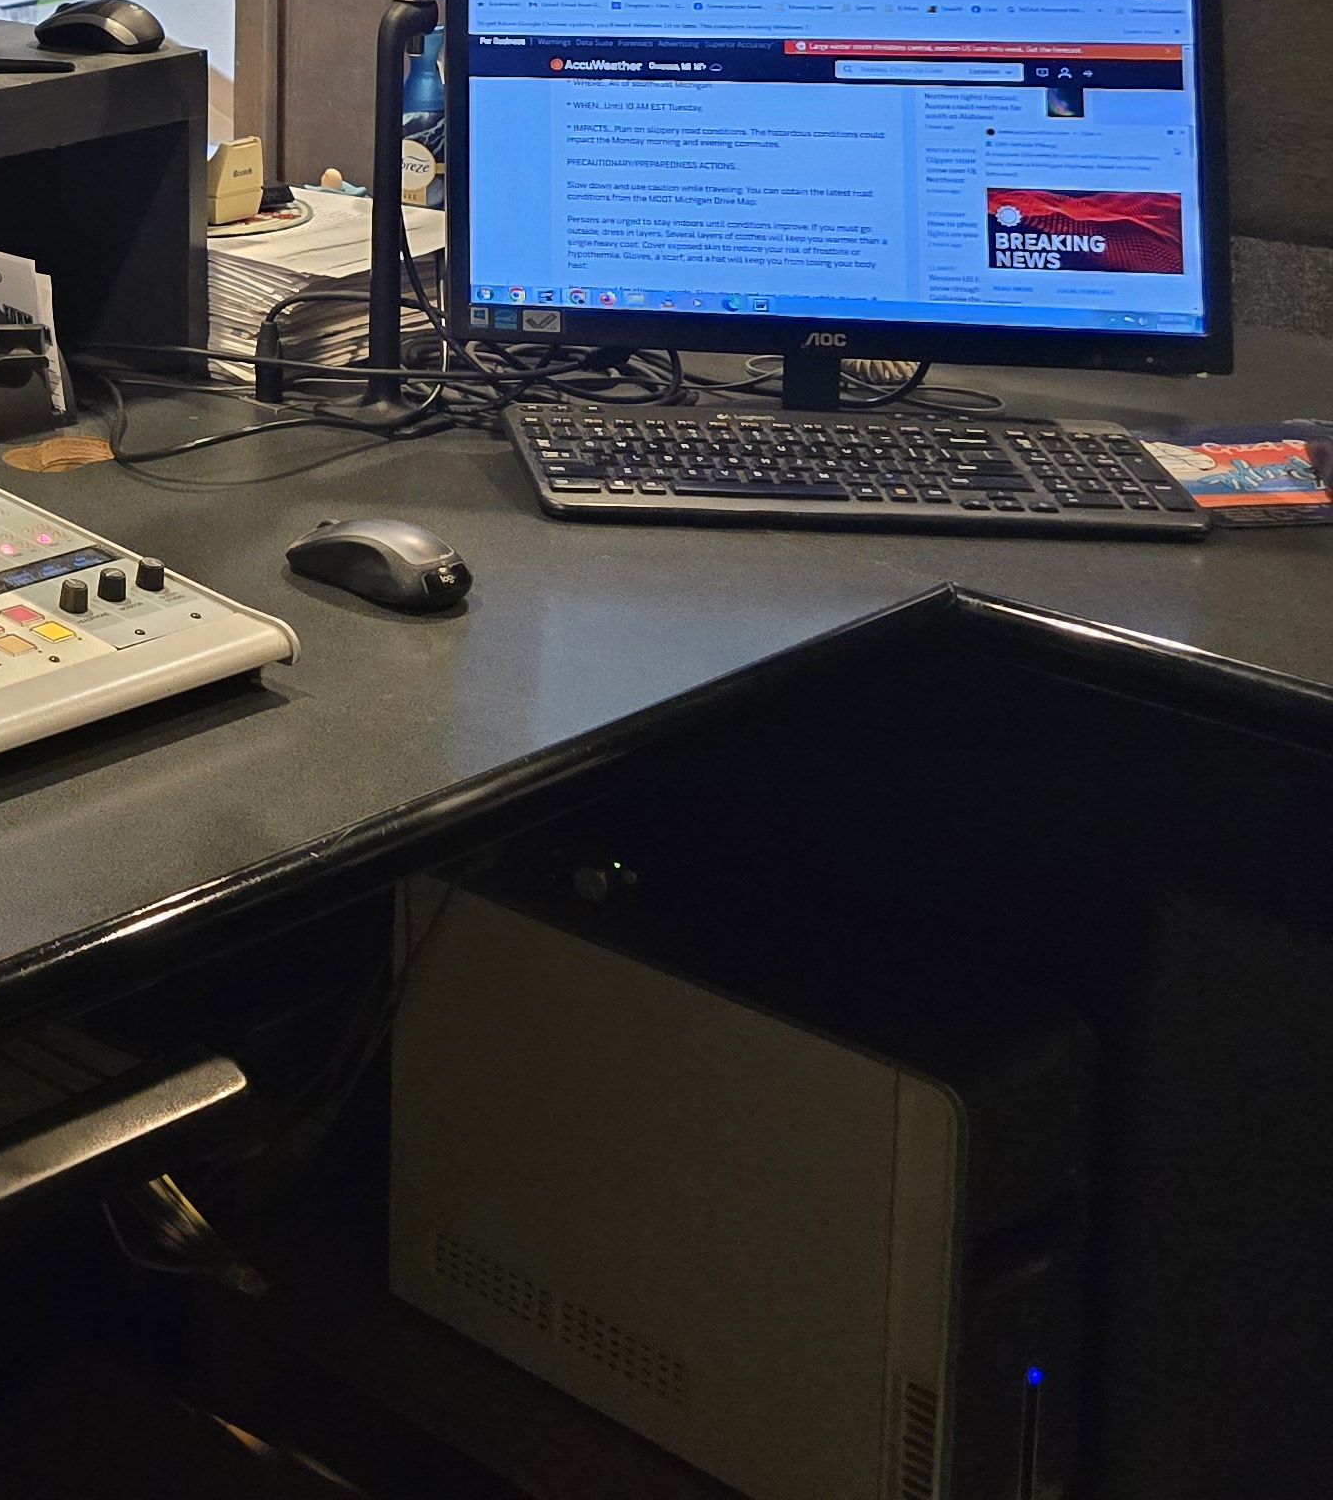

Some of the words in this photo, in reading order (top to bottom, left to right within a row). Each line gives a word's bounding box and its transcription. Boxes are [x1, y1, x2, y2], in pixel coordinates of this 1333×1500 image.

[565, 60, 642, 71] AccuWeather
[995, 233, 1105, 253] BREAKING
[996, 251, 1062, 270] NEWS
[806, 332, 847, 347] AOC
